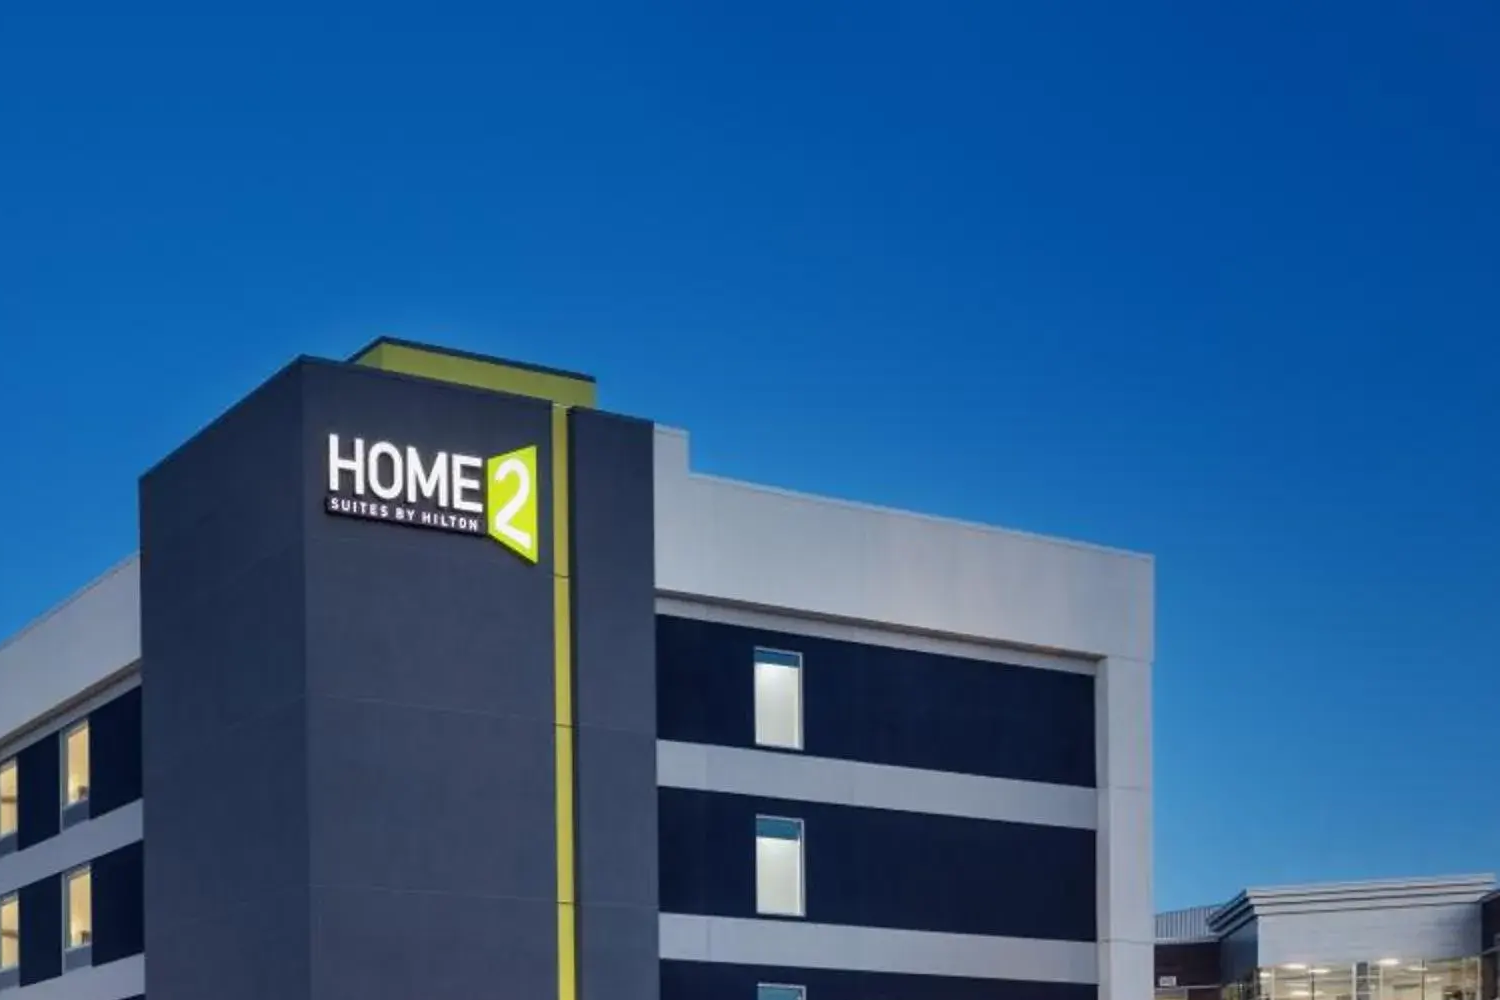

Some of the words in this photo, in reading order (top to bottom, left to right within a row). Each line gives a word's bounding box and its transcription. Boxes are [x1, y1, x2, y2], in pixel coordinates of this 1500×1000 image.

[330, 497, 390, 519] SUITES
[395, 507, 416, 521] BY
[421, 511, 479, 532] HILTON
